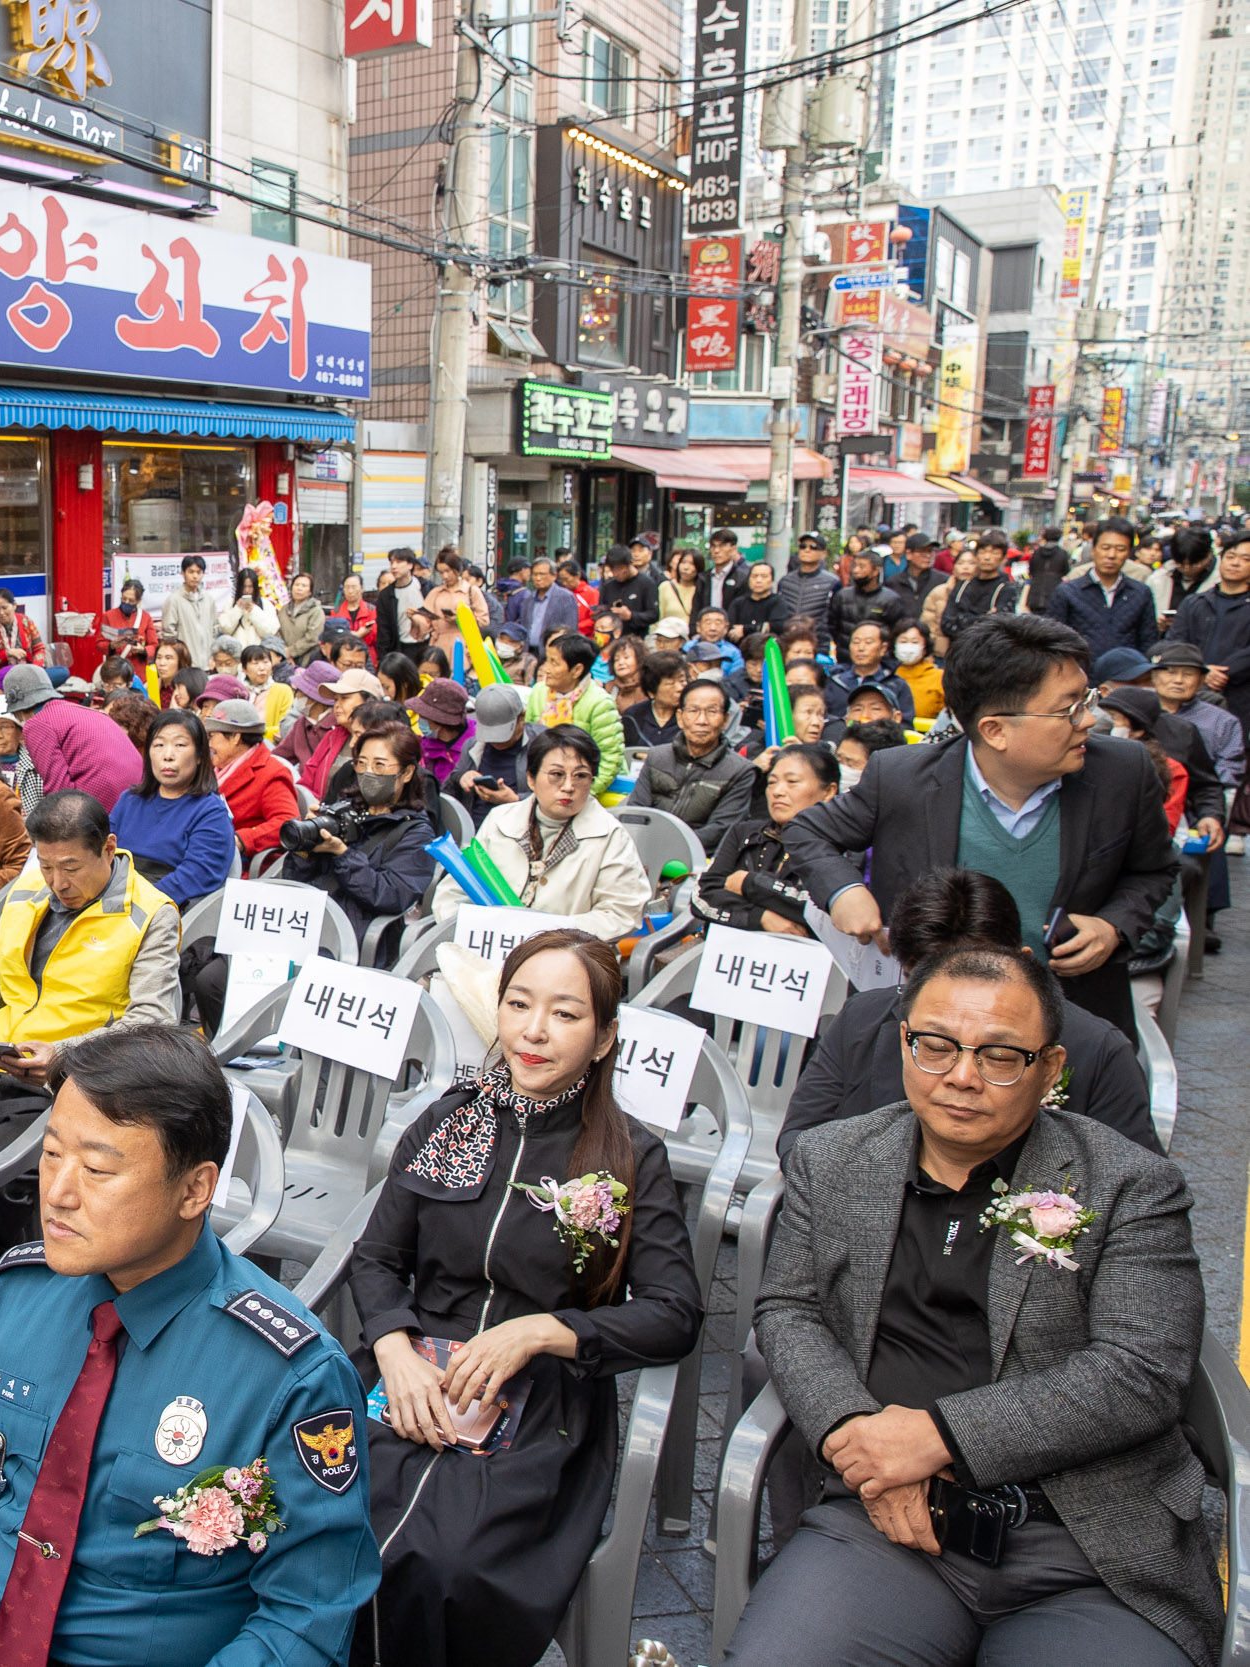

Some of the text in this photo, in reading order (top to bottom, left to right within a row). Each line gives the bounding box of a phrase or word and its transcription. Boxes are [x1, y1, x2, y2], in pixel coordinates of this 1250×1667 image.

[69, 110, 117, 151] Bar
[181, 141, 204, 173] 2F
[696, 138, 738, 165] HOF
[692, 174, 740, 200] 463-
[689, 201, 737, 225] 1833
[235, 904, 308, 937] 내빈석
[716, 955, 808, 1000] 내빈석
[305, 984, 396, 1039] 내빈석
[322, 1464, 351, 1477] POLICE
